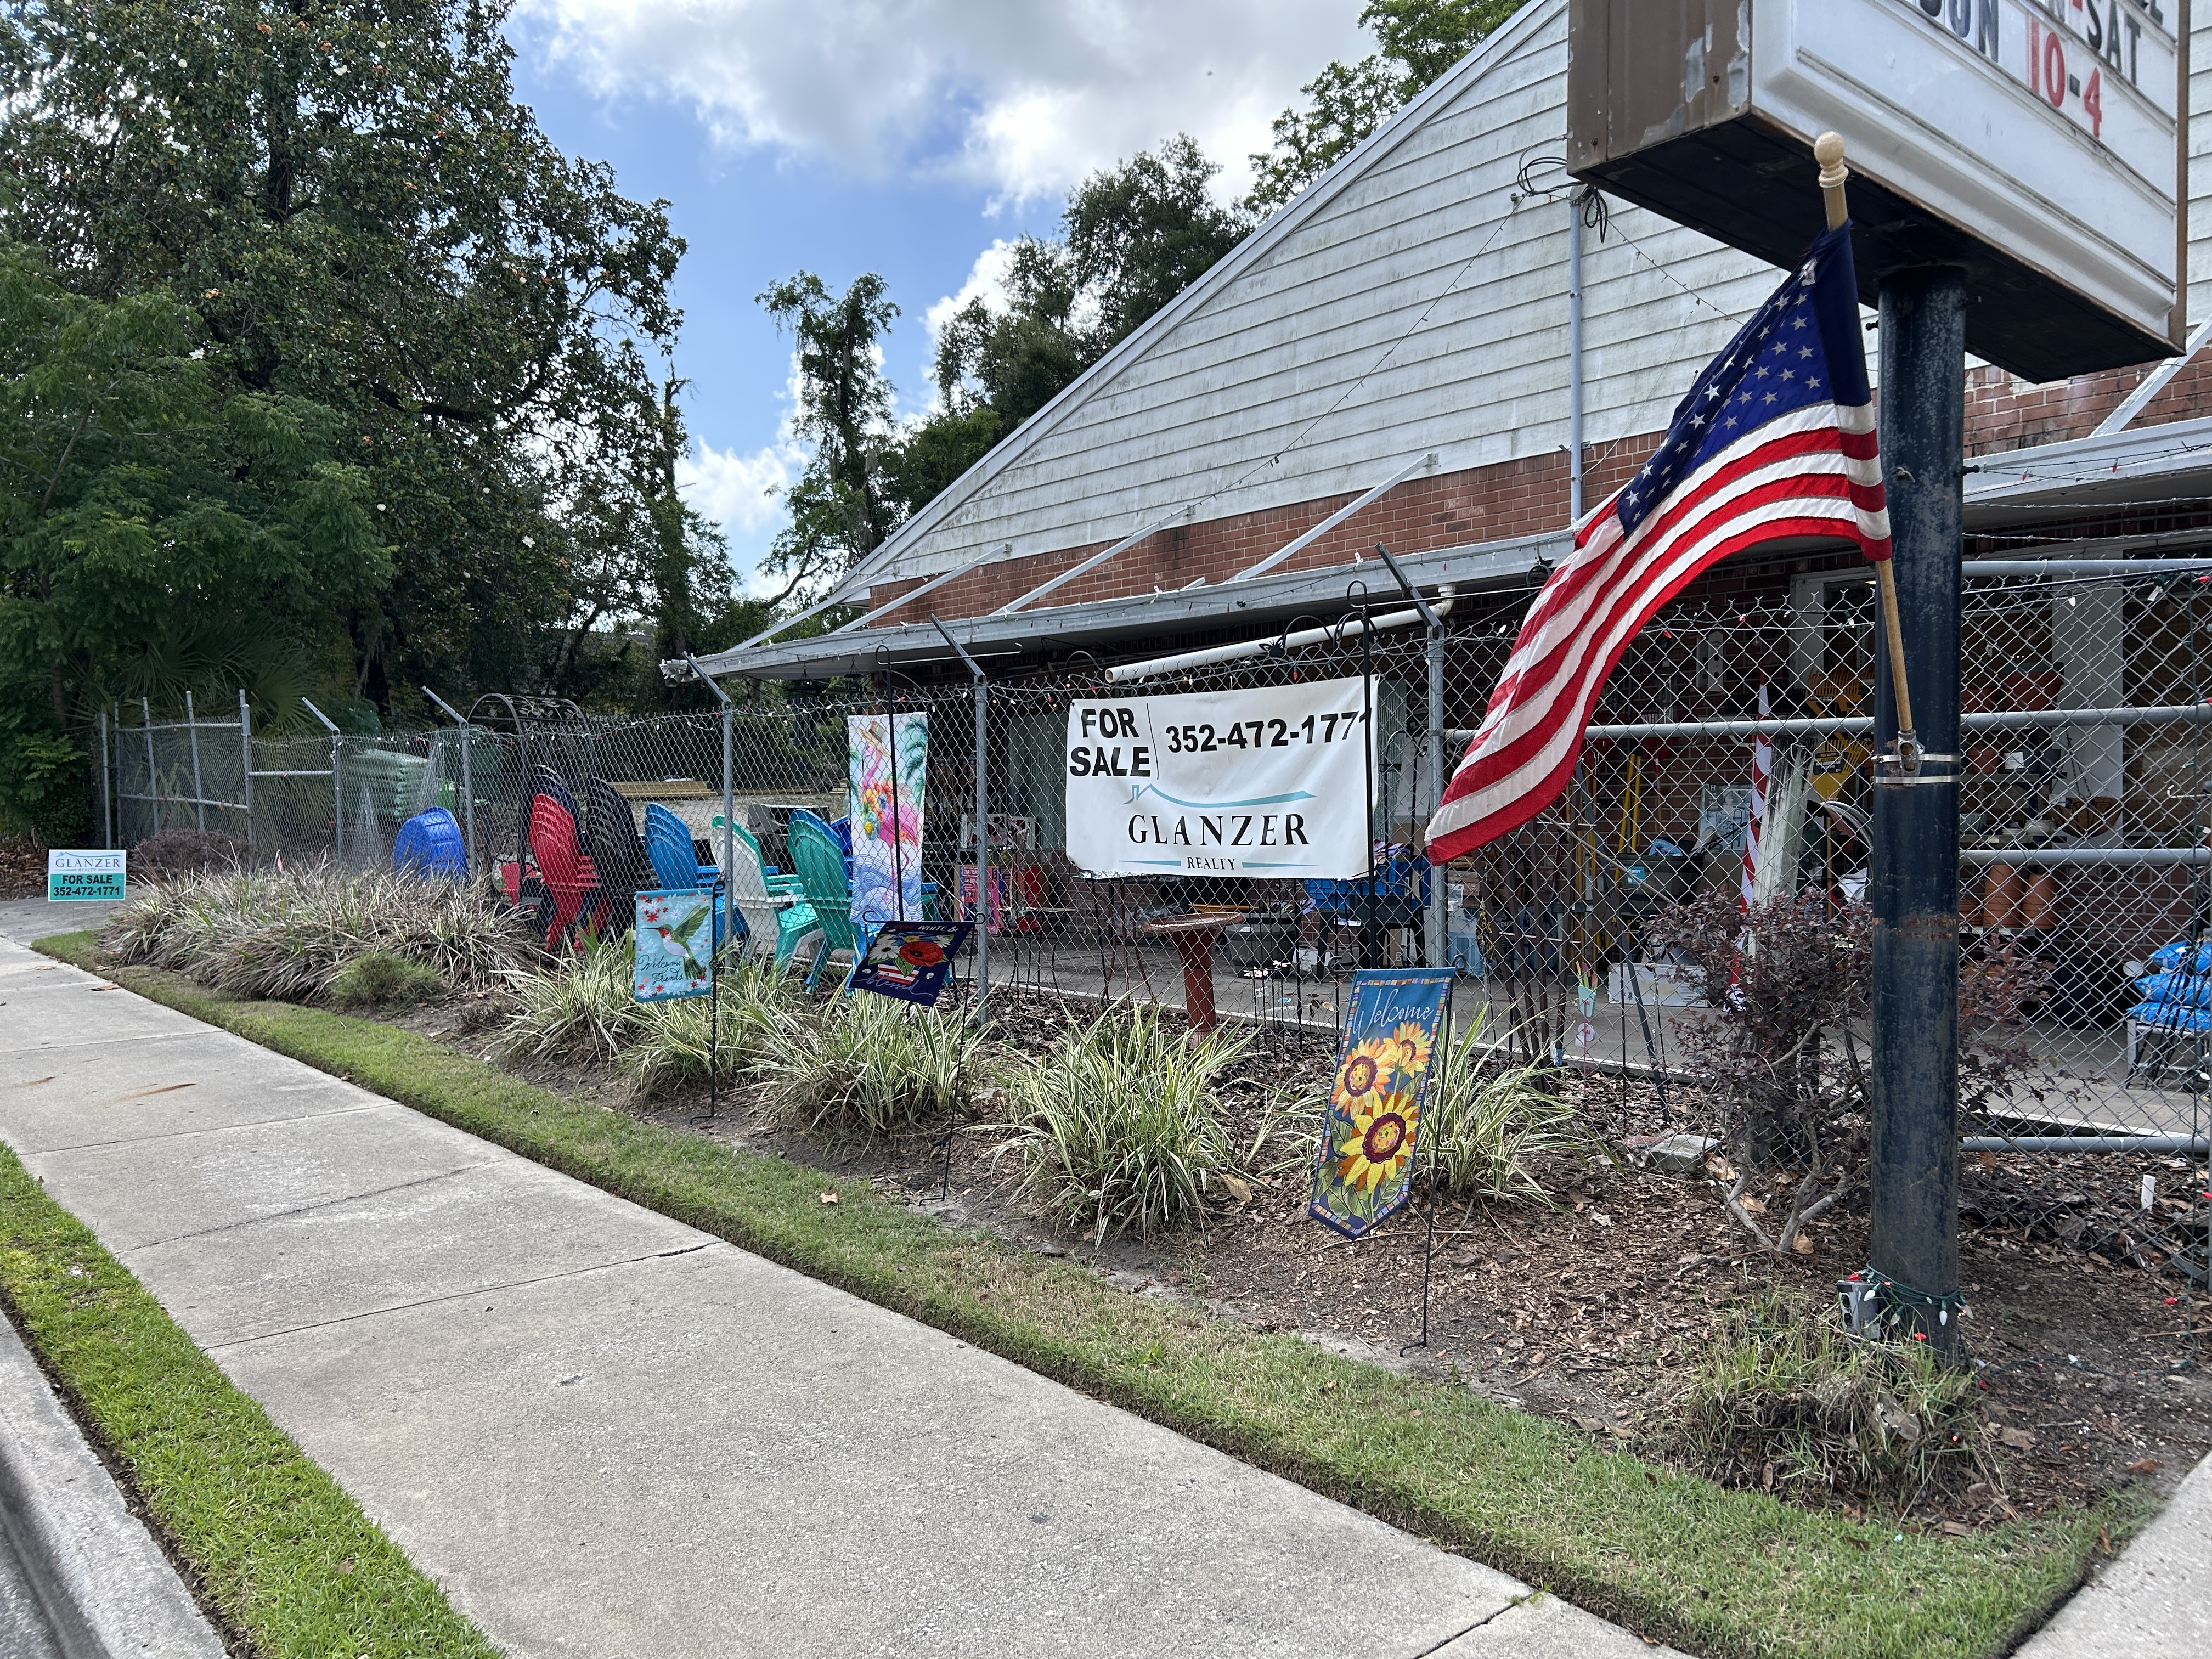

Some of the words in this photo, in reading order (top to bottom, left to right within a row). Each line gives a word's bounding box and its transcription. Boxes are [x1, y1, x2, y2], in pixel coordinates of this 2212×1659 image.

[2031, 19, 2102, 138] 10-4
[1081, 708, 1140, 738] FOR
[1069, 746, 1151, 777] SALE
[1128, 814, 1310, 846] GLANZER
[55, 858, 121, 868] GLANZER
[1187, 856, 1236, 870] REALTY
[62, 874, 83, 884] FOR
[86, 874, 113, 884] SALE
[53, 886, 120, 896] 352-472-1771
[638, 953, 682, 972] Welcome
[652, 967, 684, 985] Friends
[853, 972, 934, 997] blessed
[1353, 988, 1435, 1040] Welcome
